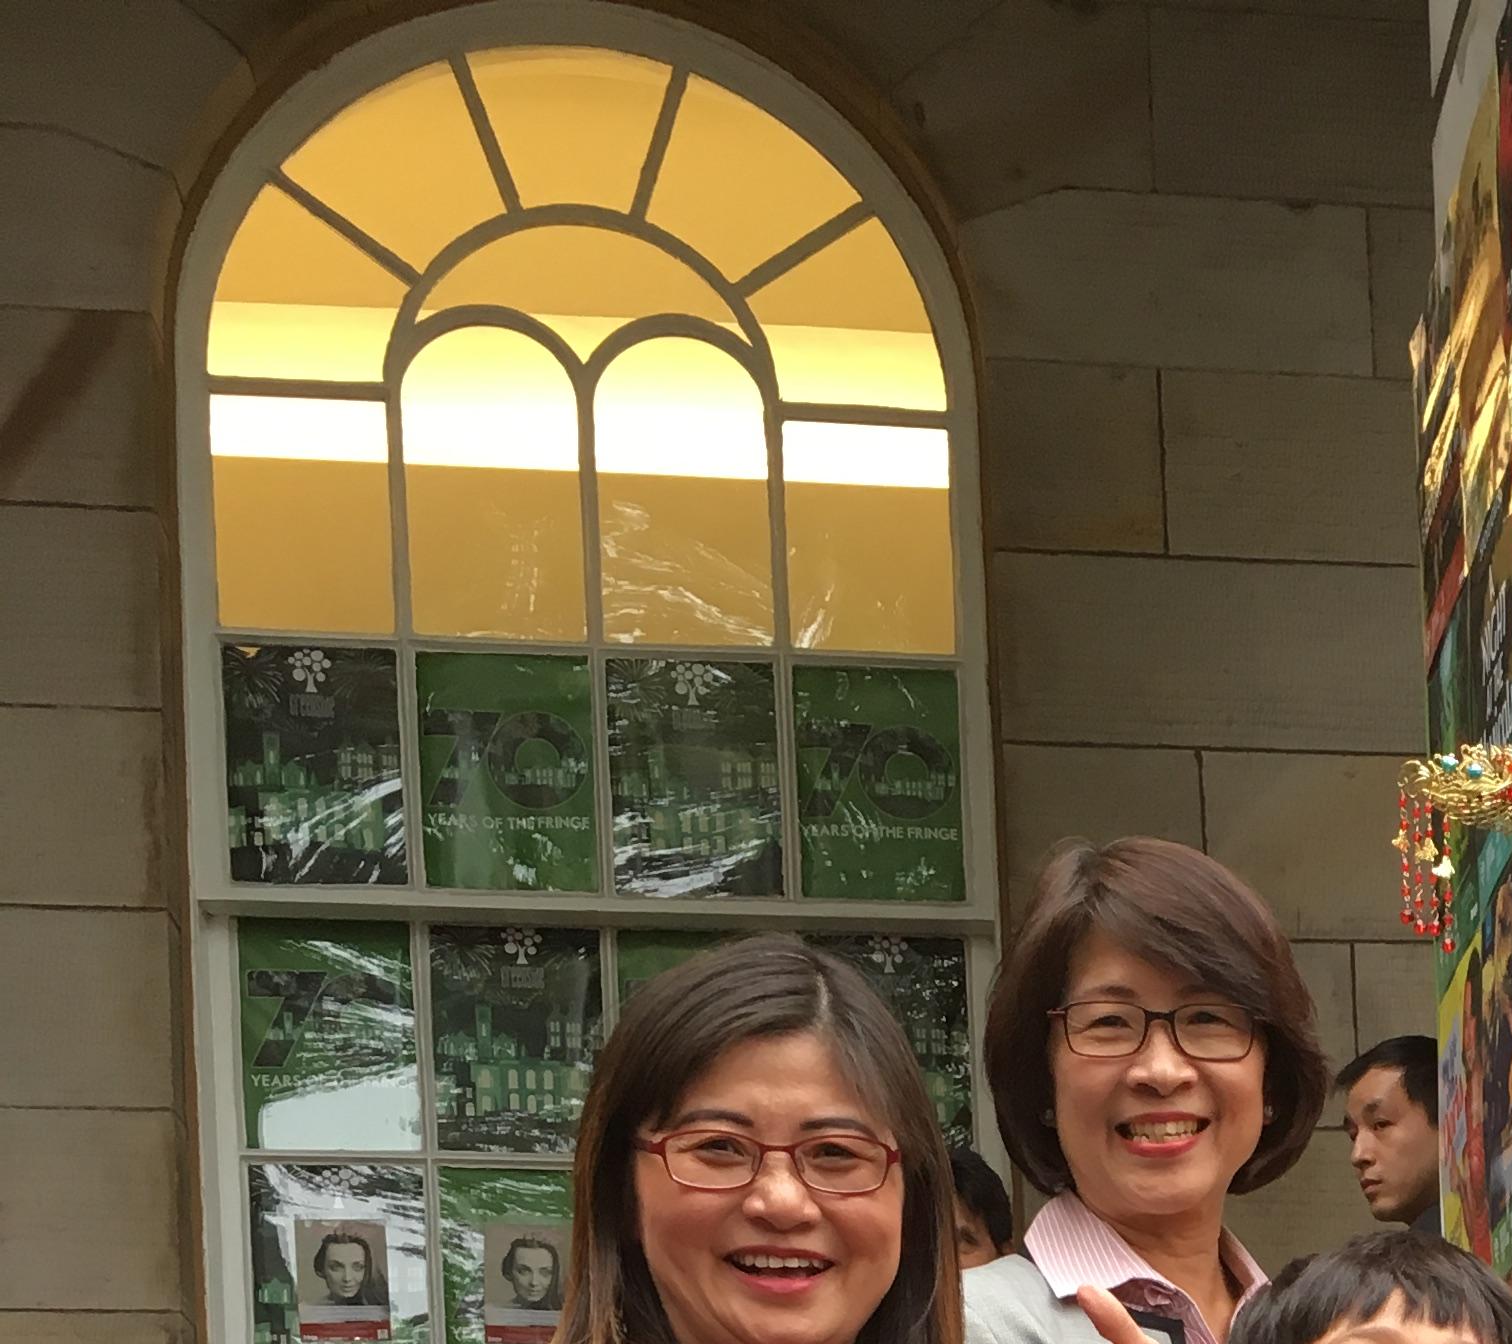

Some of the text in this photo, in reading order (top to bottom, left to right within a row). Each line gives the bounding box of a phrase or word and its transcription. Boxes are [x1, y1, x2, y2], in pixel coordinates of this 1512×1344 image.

[427, 812, 591, 832] YEARS OF THE FRINGE
[802, 822, 850, 838] YEARS
[907, 827, 959, 841] FRINGE
